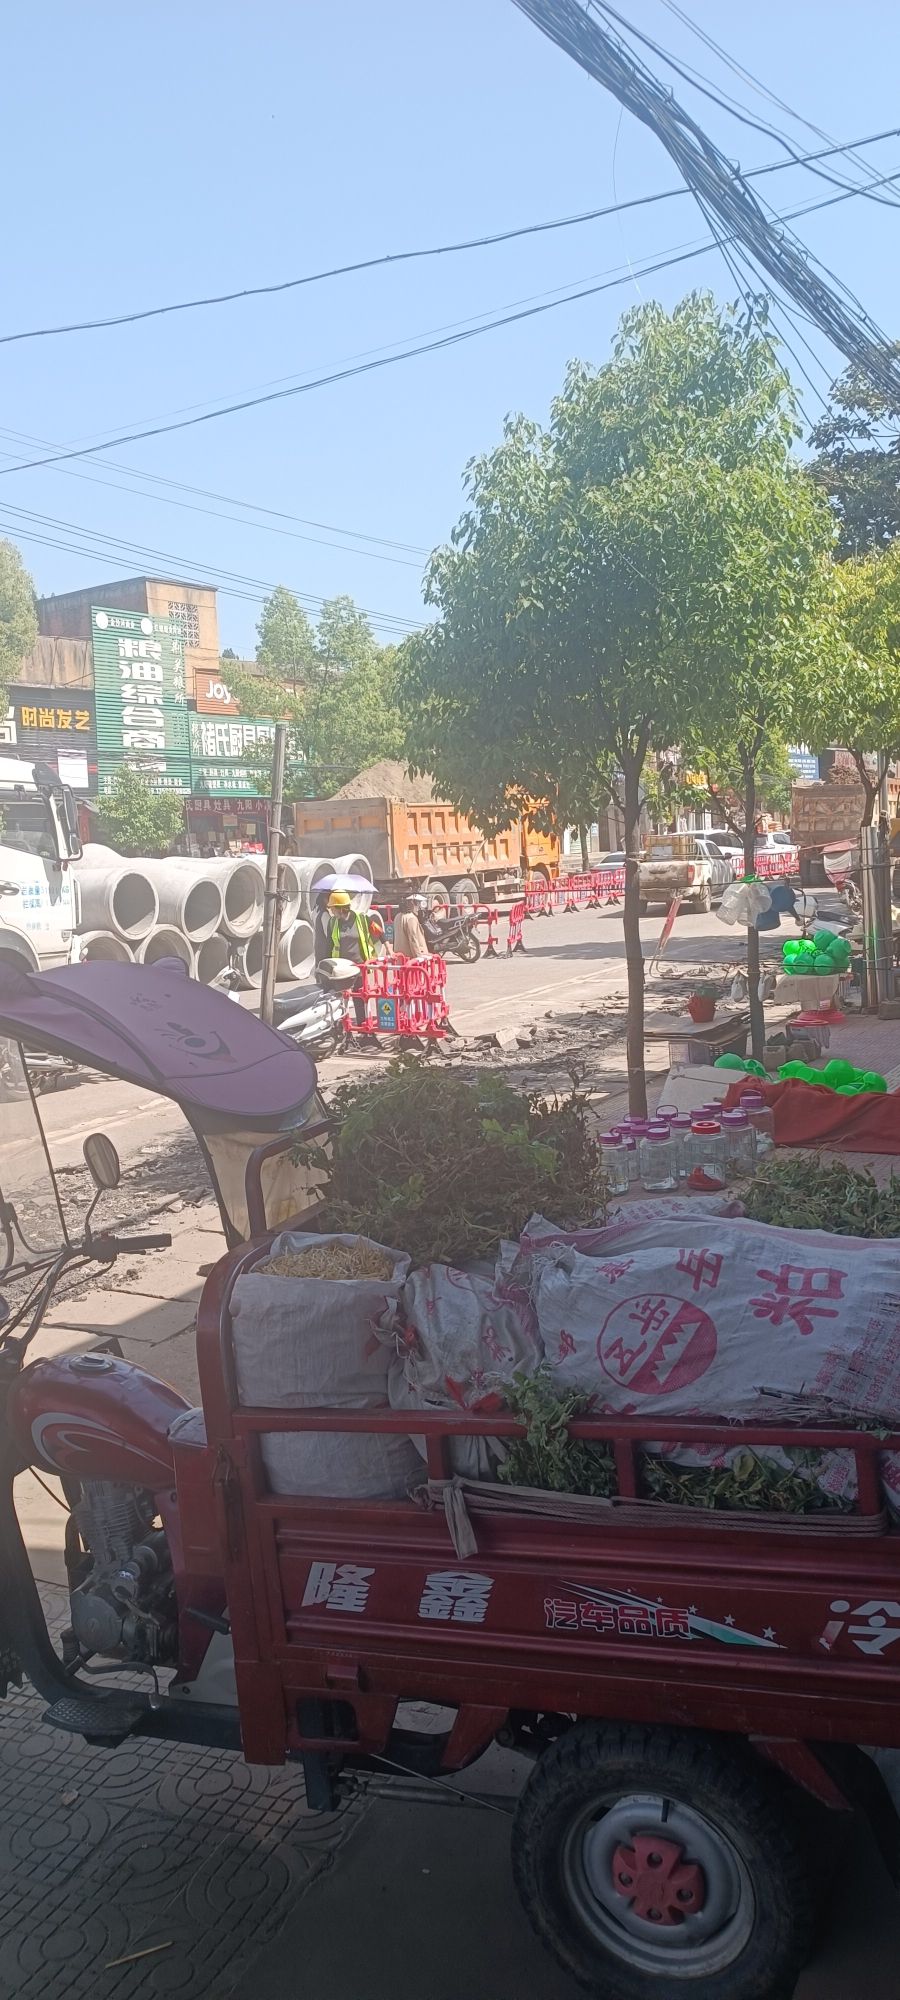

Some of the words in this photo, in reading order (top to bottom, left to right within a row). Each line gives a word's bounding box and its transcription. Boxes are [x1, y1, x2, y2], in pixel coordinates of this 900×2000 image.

[21, 706, 91, 731] 时尚发艺
[302, 1561, 495, 1623] 隆鑫
[543, 1597, 694, 1641] 汽车品质
